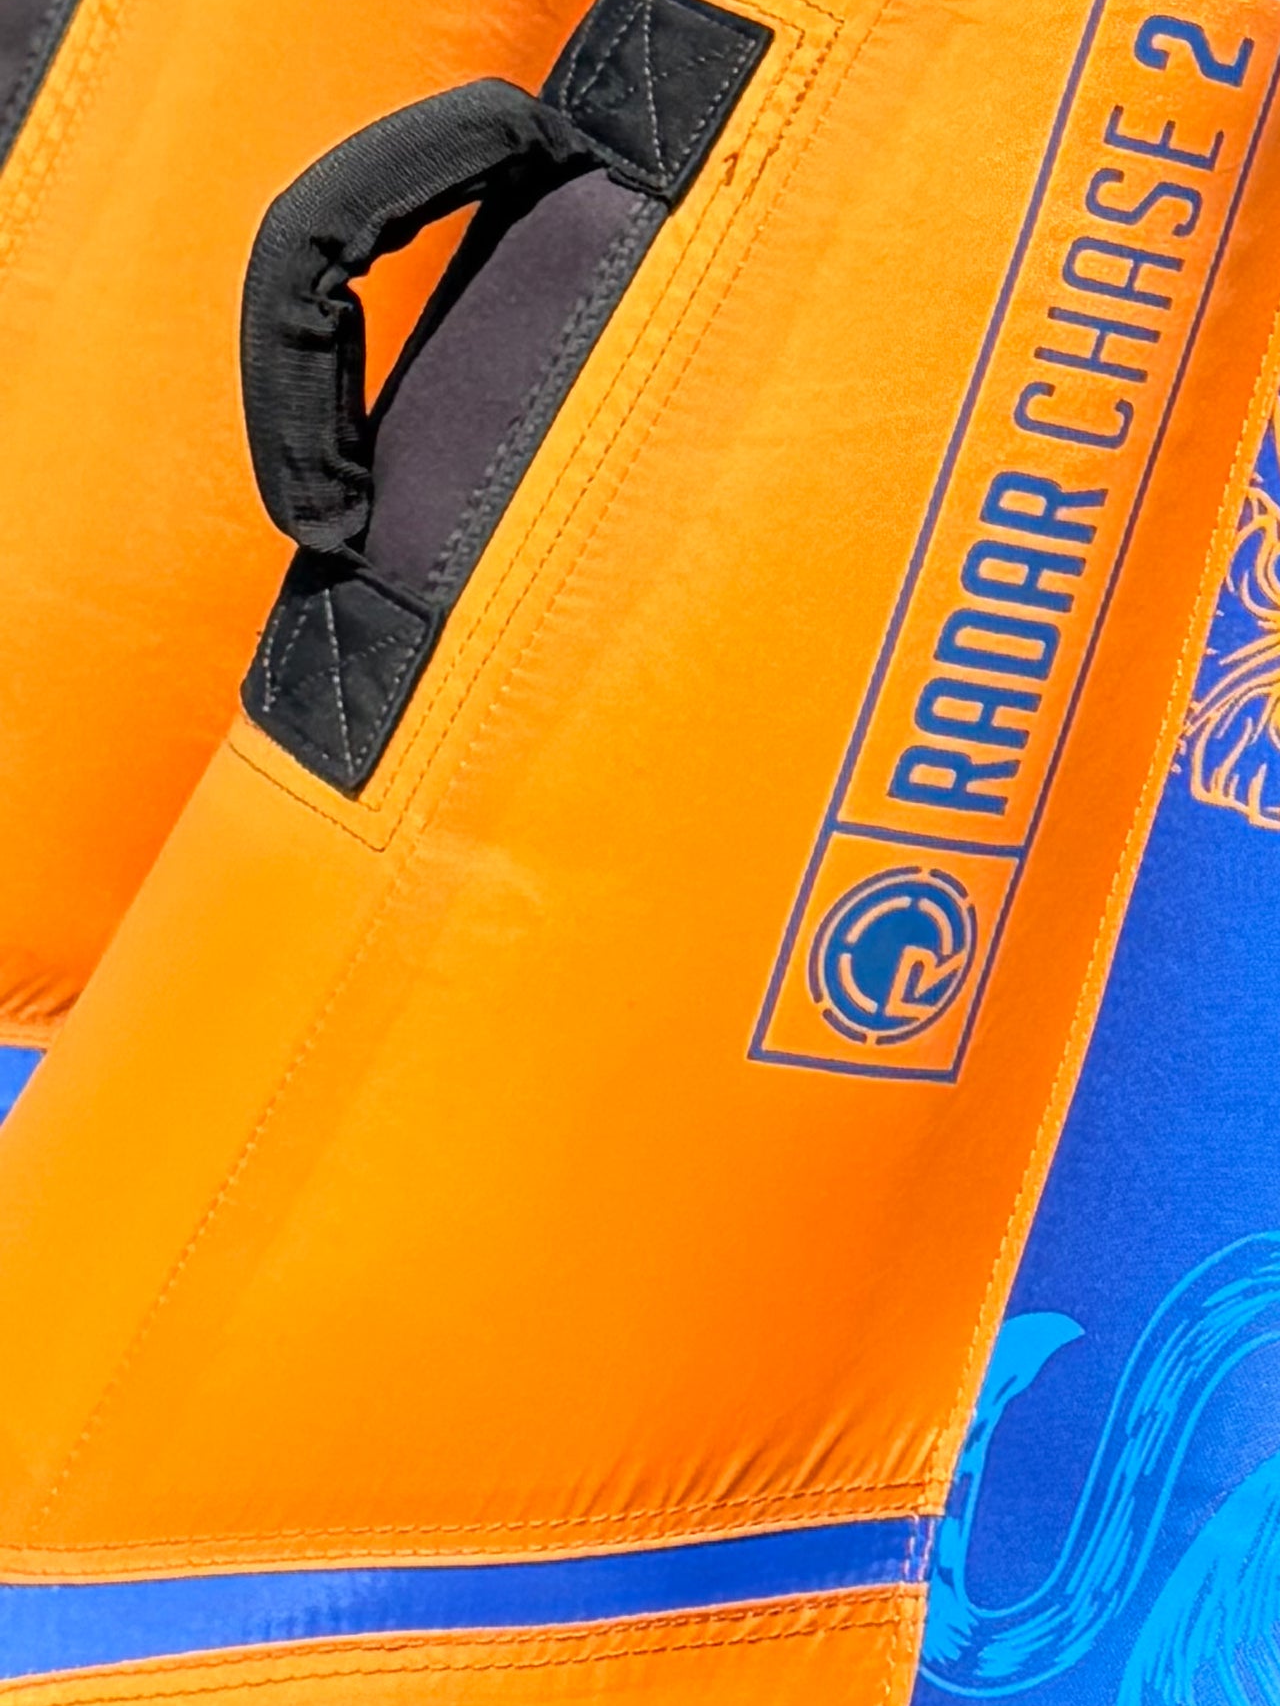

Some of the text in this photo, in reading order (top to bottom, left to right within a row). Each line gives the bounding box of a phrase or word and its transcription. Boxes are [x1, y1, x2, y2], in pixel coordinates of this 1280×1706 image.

[887, 13, 1256, 817] RADAR CHASE 2
